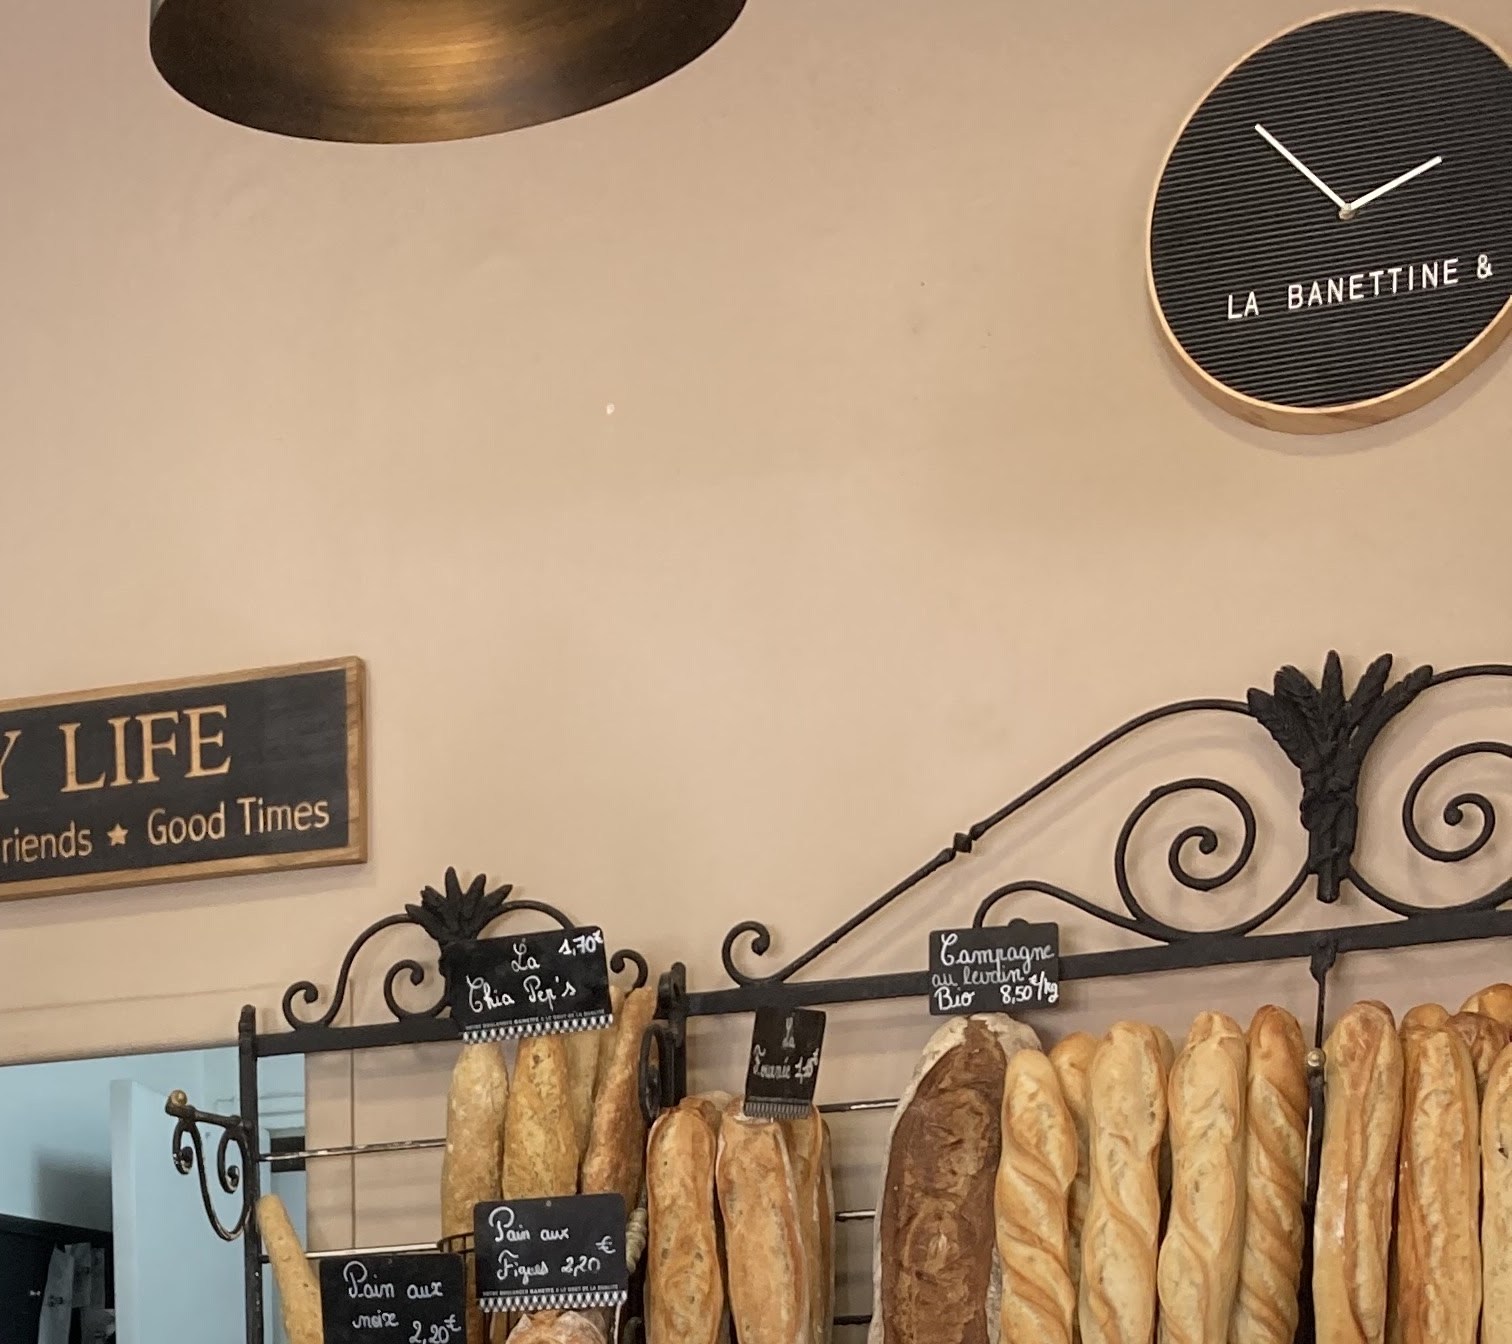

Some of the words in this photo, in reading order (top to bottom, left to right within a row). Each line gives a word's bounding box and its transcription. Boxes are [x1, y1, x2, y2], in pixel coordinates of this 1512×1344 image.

[1227, 291, 1260, 321] LA
[1288, 257, 1459, 310] BANETTINE
[1476, 253, 1493, 279] &
[58, 703, 232, 794] LIFE
[147, 804, 226, 846] Good
[236, 796, 330, 836] Times
[941, 933, 1055, 974] Campagne
[466, 975, 515, 1013] Chia
[931, 972, 959, 987] au
[934, 985, 975, 1011] Bio
[488, 1206, 530, 1242] Pain
[540, 1226, 569, 1242] aux
[343, 1261, 395, 1298] Pain
[406, 1281, 443, 1298] aux
